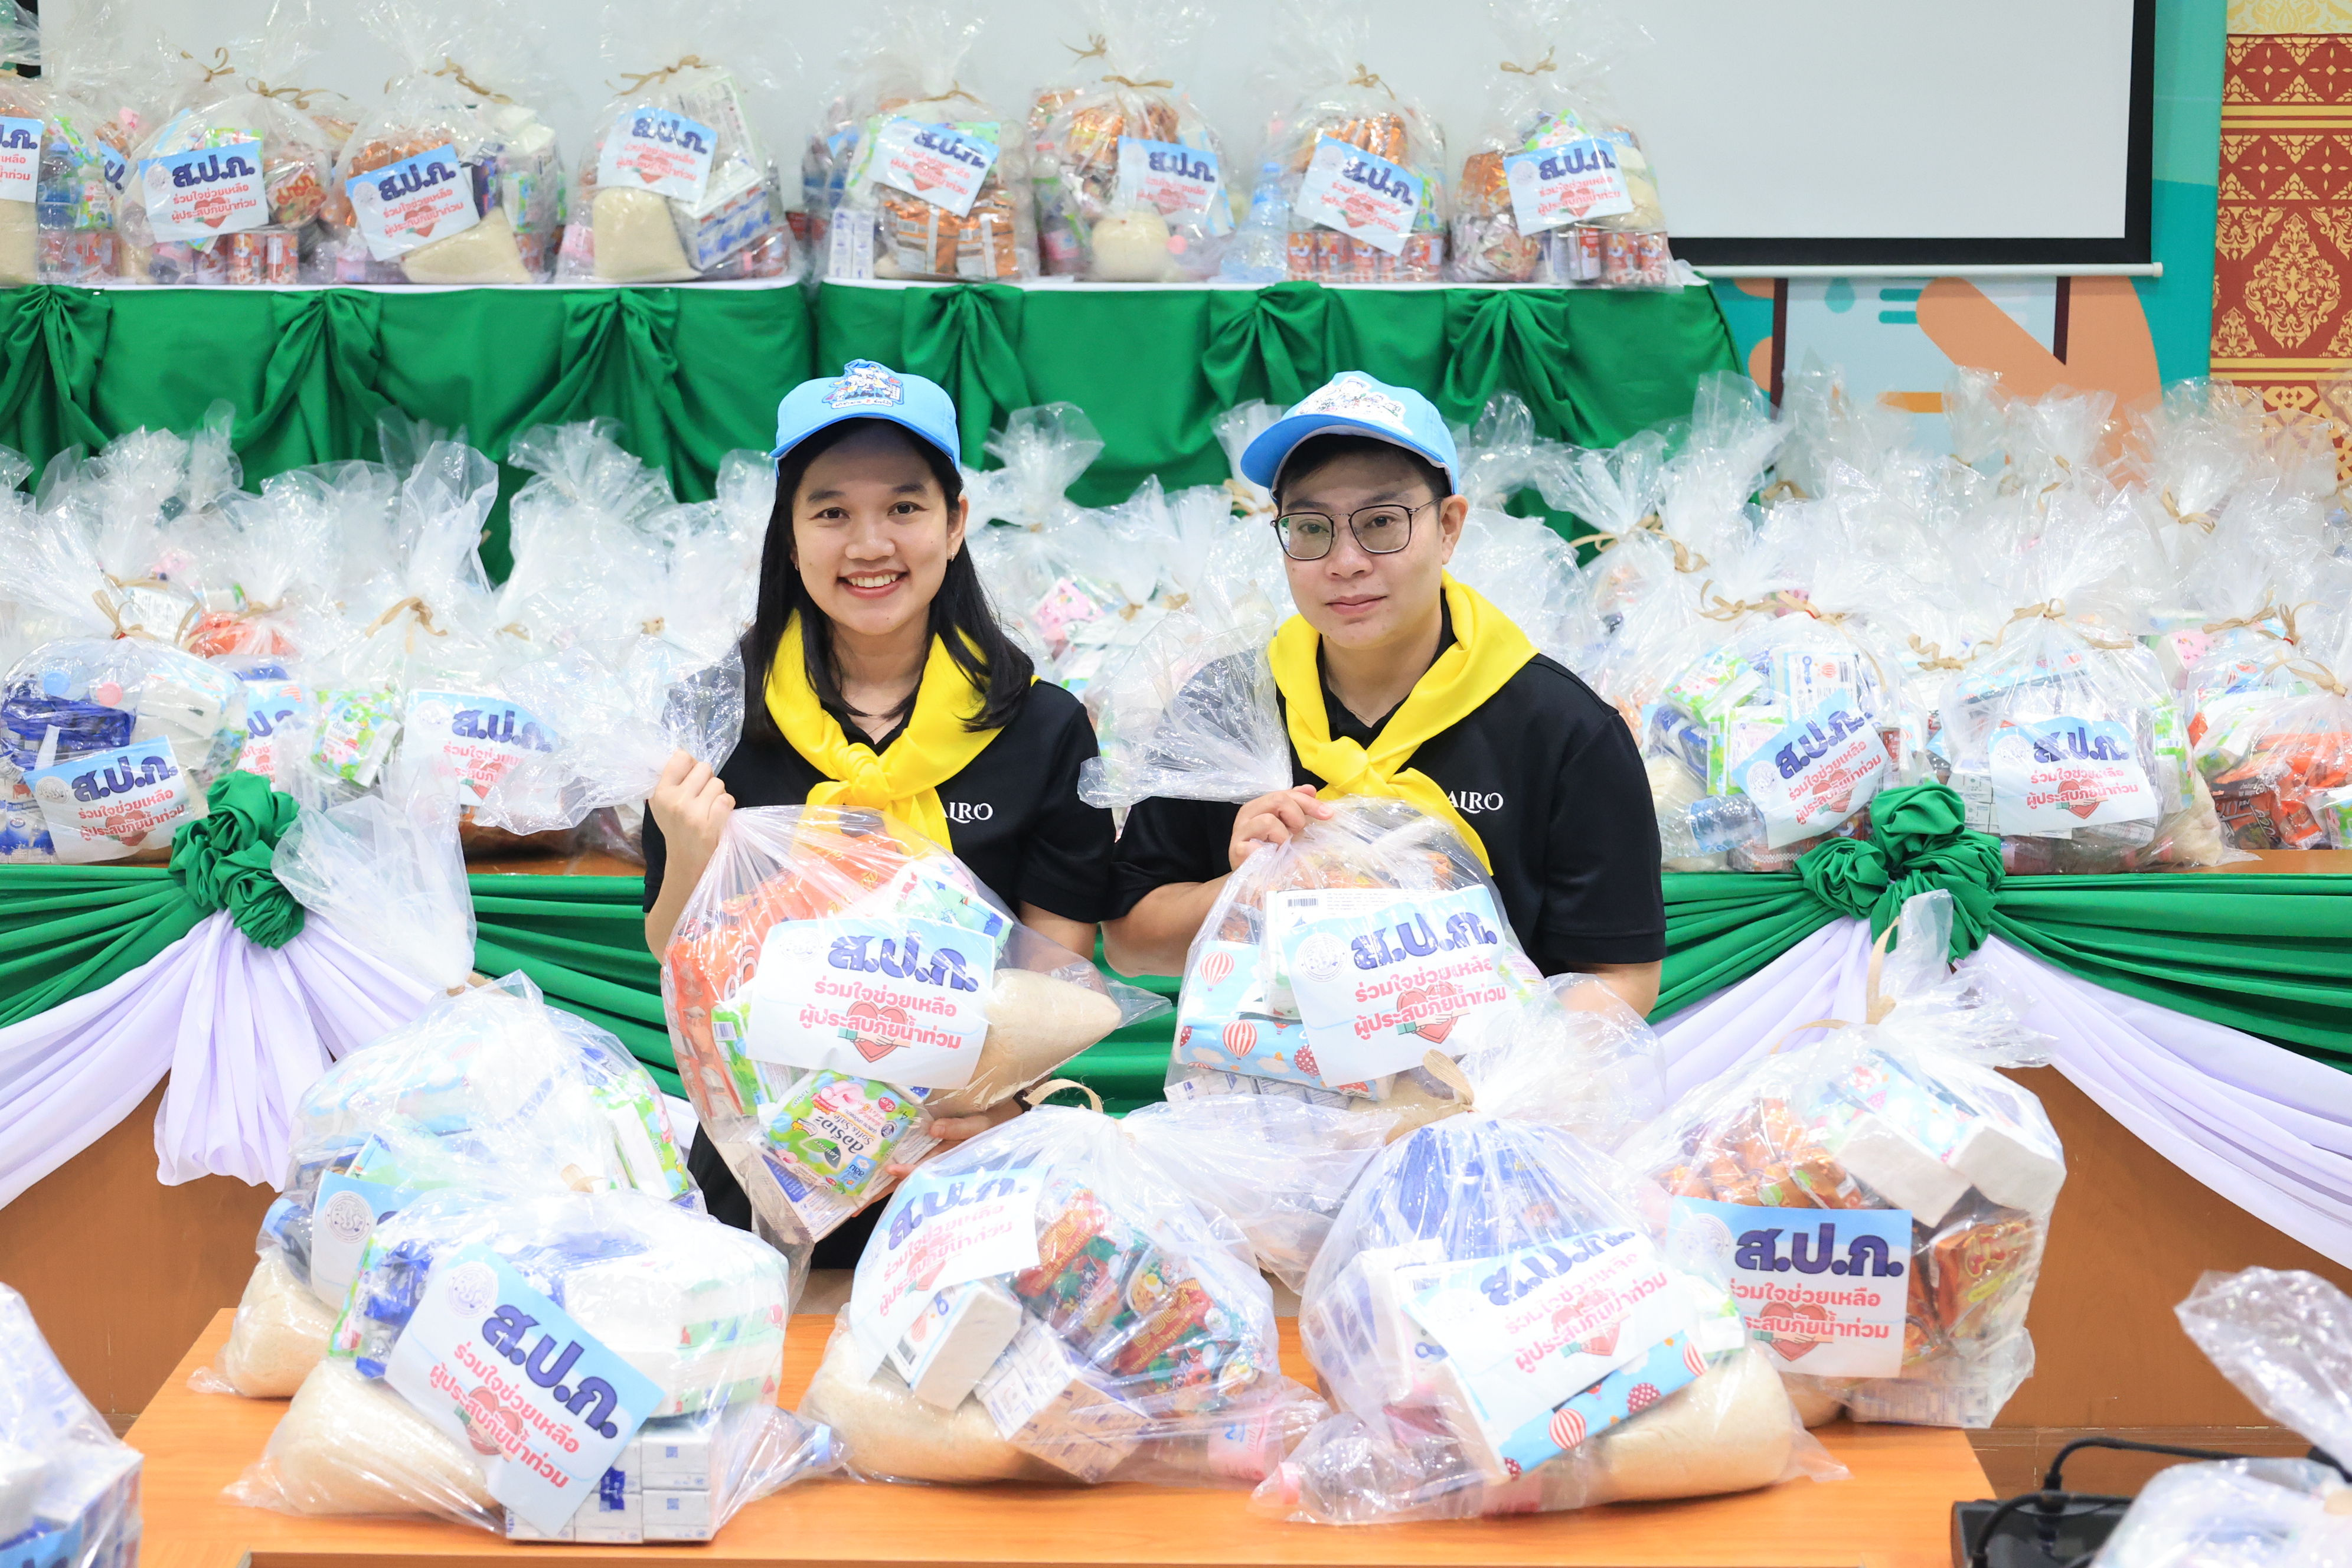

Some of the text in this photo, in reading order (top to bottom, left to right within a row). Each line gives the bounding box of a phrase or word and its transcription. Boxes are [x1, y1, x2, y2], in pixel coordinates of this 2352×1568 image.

[172, 155, 255, 188] ส.ป.ก.
[379, 162, 456, 201] ส.ป.ก.
[1540, 148, 1616, 180] ส.ป.ก.
[71, 754, 178, 802] ส.ป.ก.
[1789, 740, 1866, 801] ร่วมใจช่วยเหลือ
[1796, 753, 1882, 825] ผู้ประสบภัยน้ำท่วม
[2030, 767, 2124, 785] ร่วมใจช่วยเหลือ
[79, 788, 174, 819] ร่วมใจช่วยเหลือ
[944, 802, 993, 824] LRO
[2026, 781, 2139, 809] ผู้ประสบภัยน้ำท่วม
[828, 930, 979, 992] ส.ป.ก.
[1351, 911, 1498, 971] ส.ป.ก.
[815, 976, 958, 1018] ร่วมใจช่วยเหลือ
[1354, 955, 1492, 1003] ร่วมใจช่วยเหลือ
[799, 1005, 962, 1052] ผู้ประสบภัยน้ำท่วม
[1354, 978, 1508, 1040] ผู้ประสบภัยน้ำท่วม
[832, 1113, 852, 1130] Safe
[862, 1102, 871, 1112] 5
[886, 1102, 894, 1111] 12
[813, 1138, 839, 1161] Laurier
[815, 1115, 864, 1154] ลอรีเอะ
[854, 1129, 873, 1145] Soft
[1734, 1223, 1904, 1277] ส.ป.ก.
[482, 1304, 620, 1440] ส.ป.ก.
[453, 1341, 581, 1455] ร่วมใจช่วยเหลือ
[429, 1363, 570, 1488] ผู้ประสบภัยน้ำท่วม
